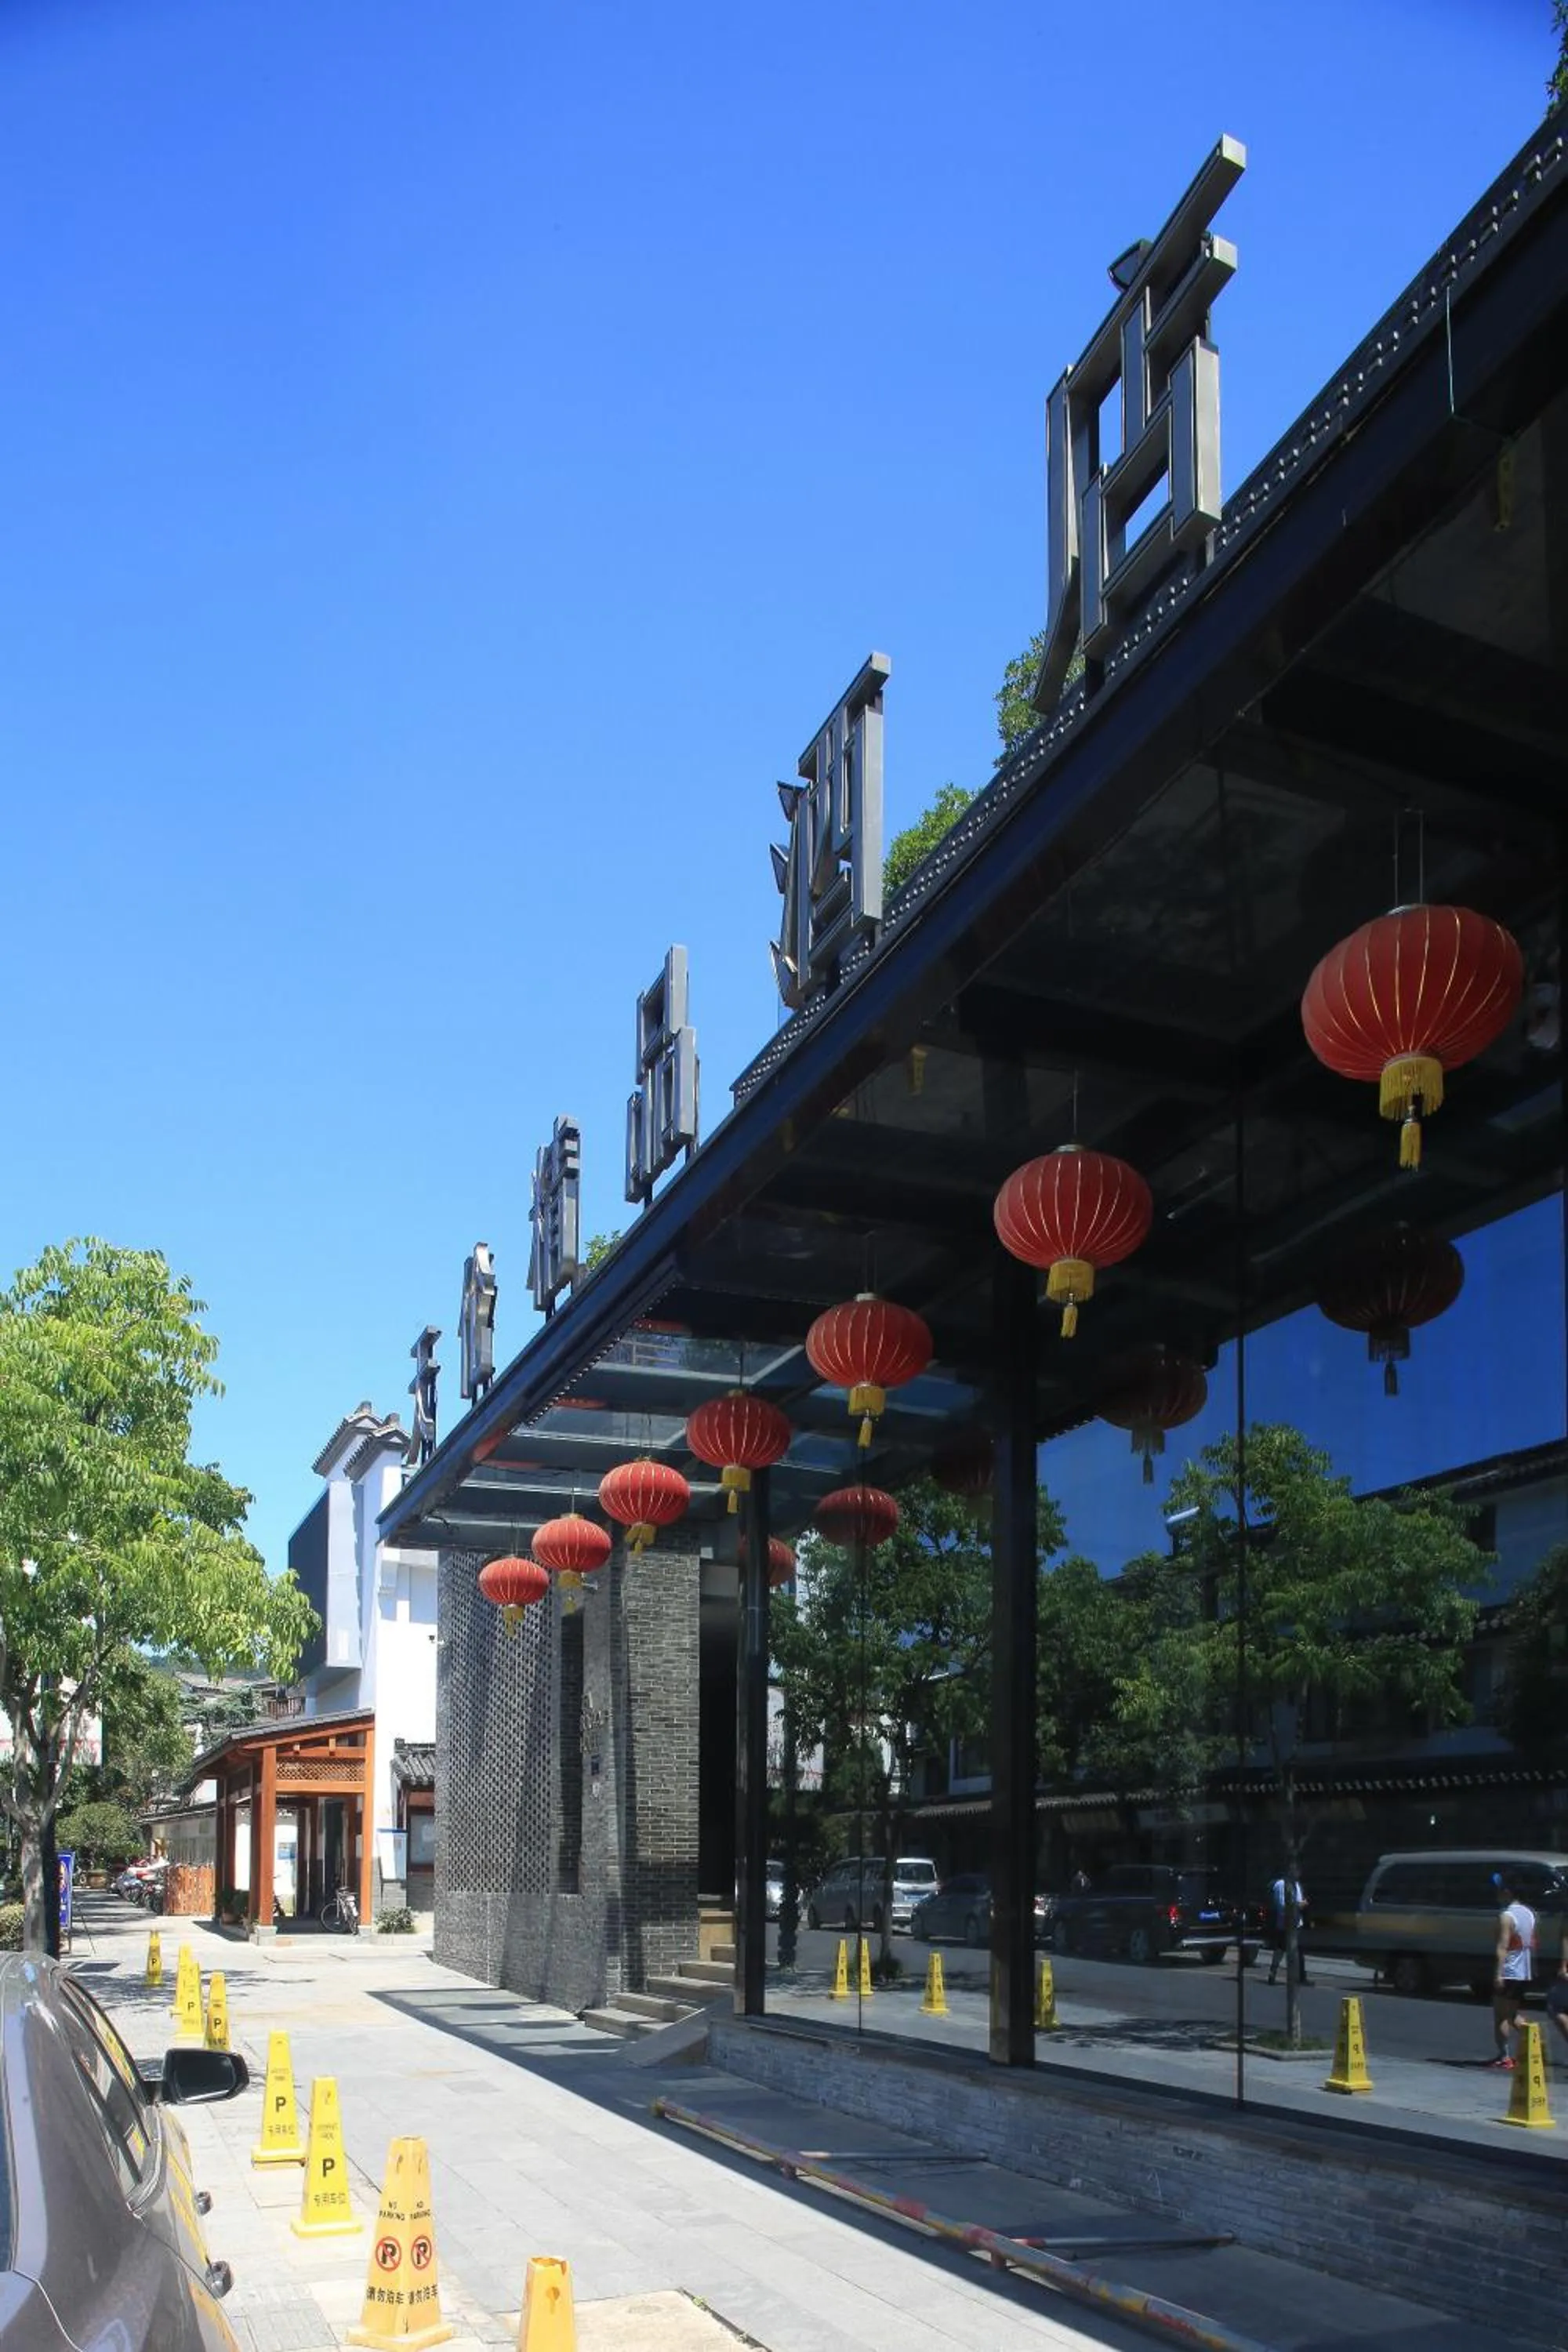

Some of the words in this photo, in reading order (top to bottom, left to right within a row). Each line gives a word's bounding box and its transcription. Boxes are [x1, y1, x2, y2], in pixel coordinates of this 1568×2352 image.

[187, 2002, 194, 2012] P
[214, 2018, 222, 2029] P
[276, 2096, 286, 2112] P
[322, 2158, 335, 2177] P
